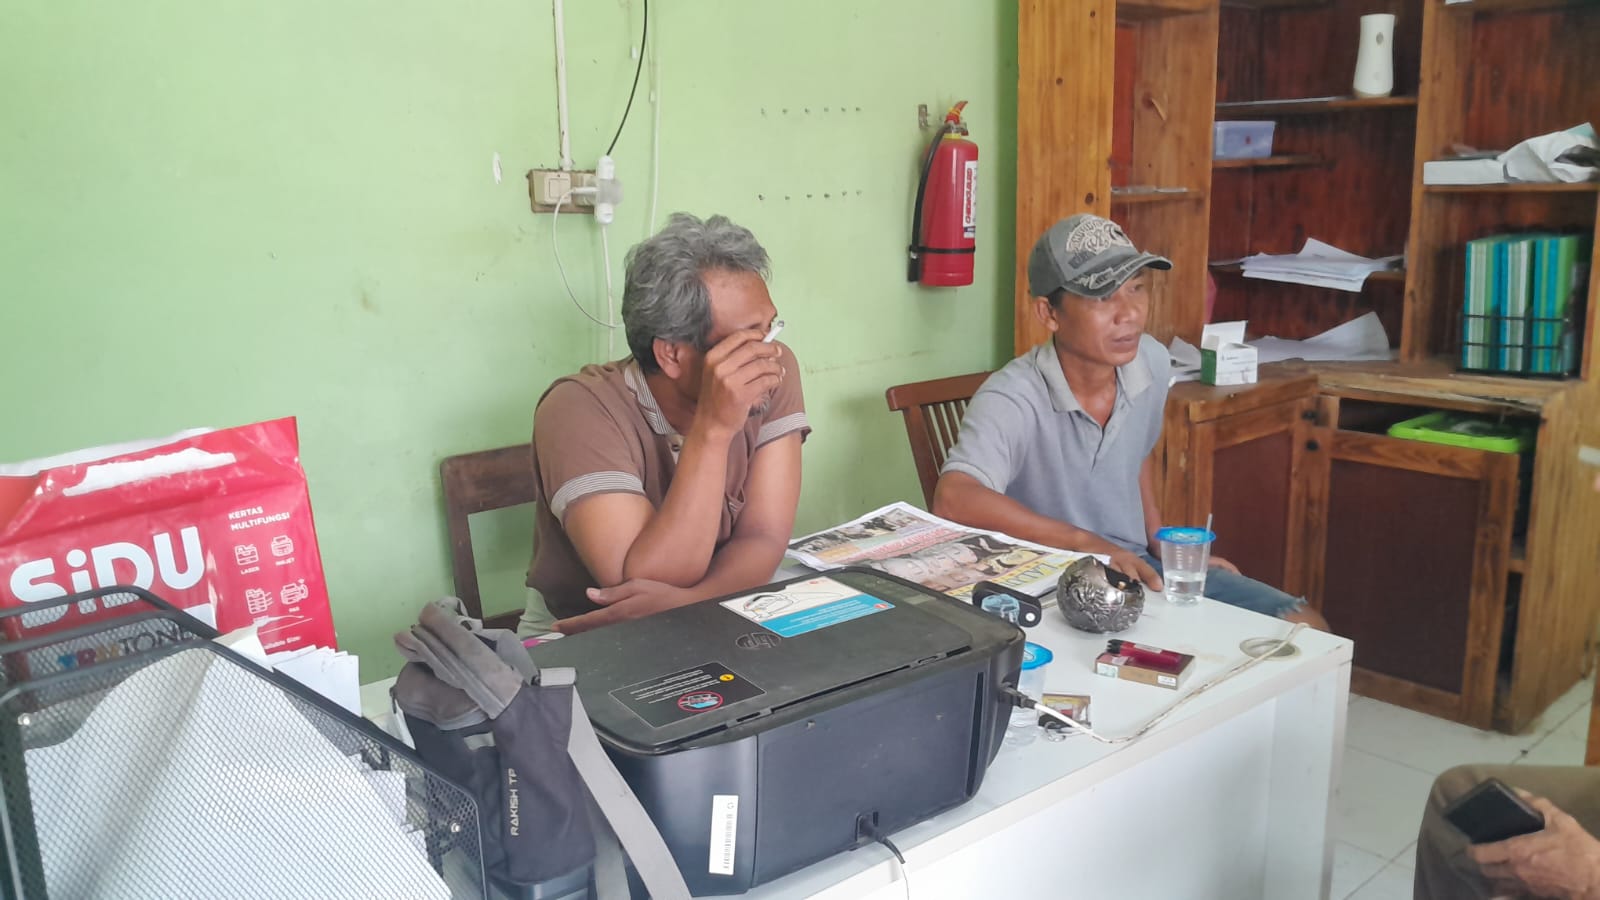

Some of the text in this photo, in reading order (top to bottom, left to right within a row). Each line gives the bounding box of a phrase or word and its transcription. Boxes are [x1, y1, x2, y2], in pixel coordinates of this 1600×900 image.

[228, 506, 264, 521] KERTAS
[230, 511, 291, 531] MULTIFUNGSI
[508, 768, 519, 836] RAKISH TP
